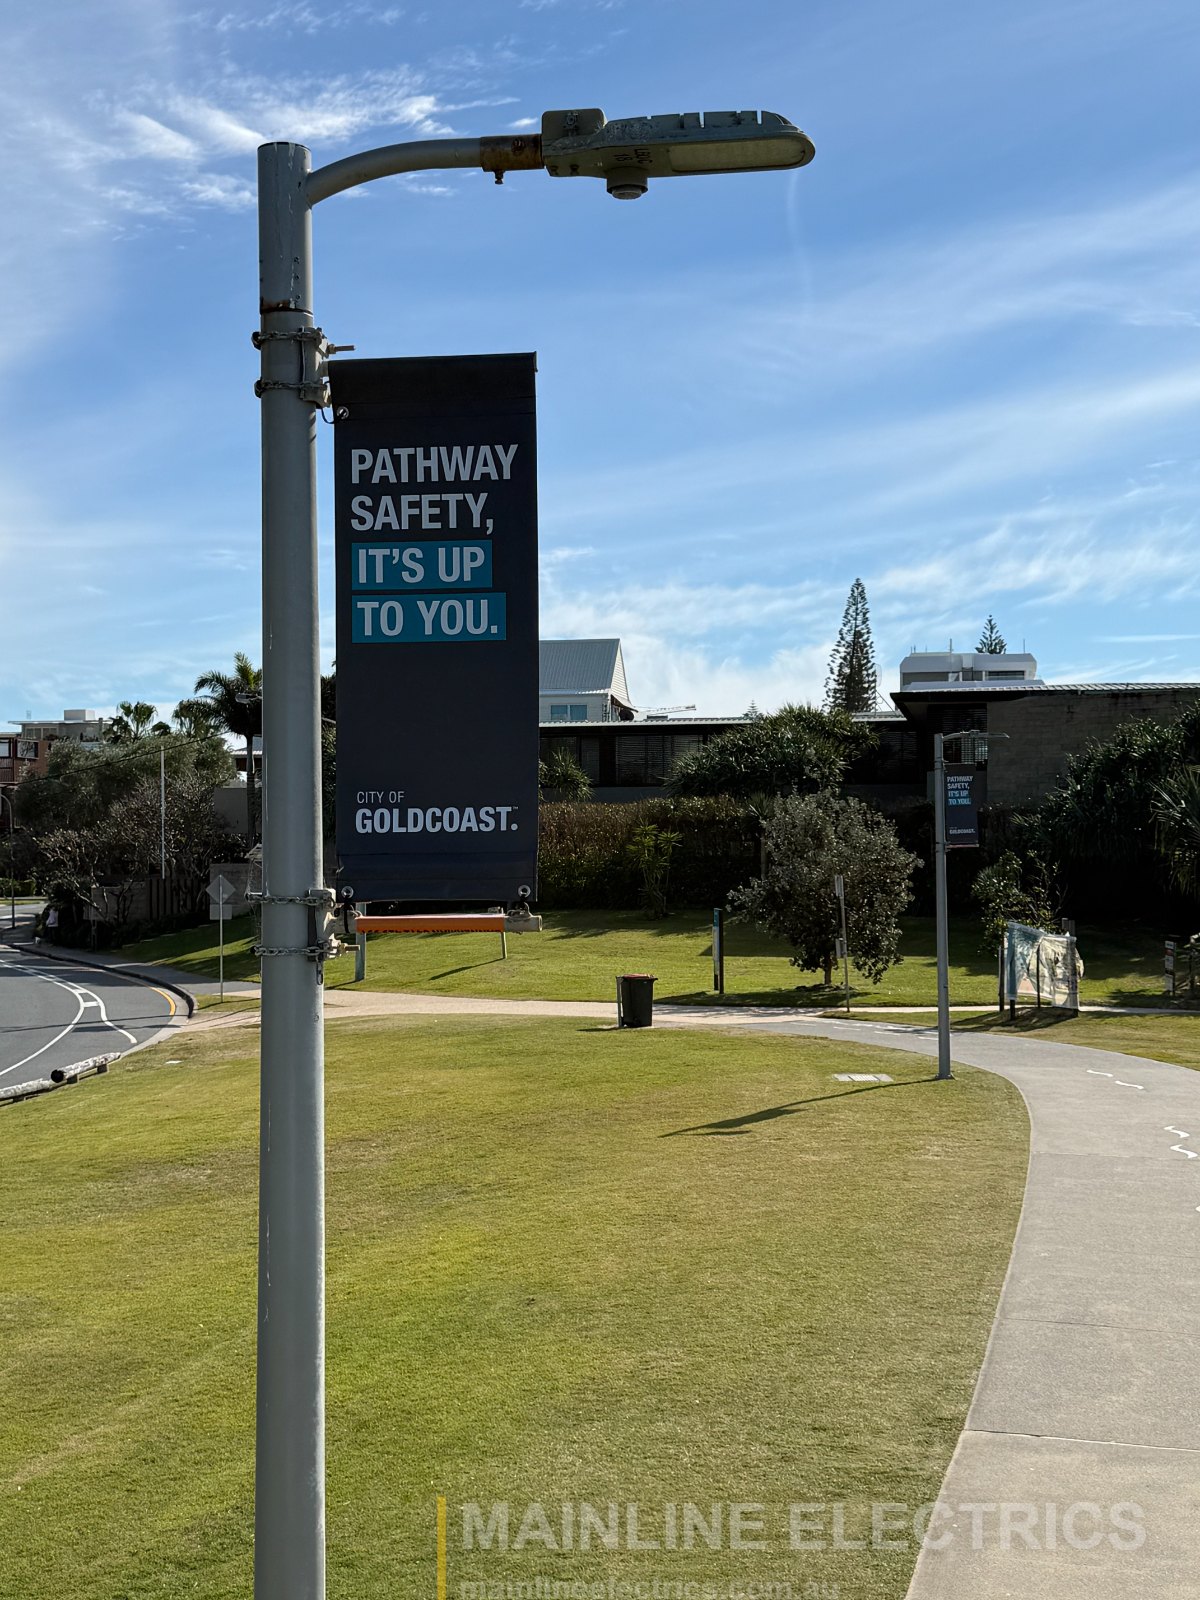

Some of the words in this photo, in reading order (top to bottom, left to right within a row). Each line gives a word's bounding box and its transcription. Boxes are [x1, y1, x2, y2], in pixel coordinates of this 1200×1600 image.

[351, 444, 519, 484] PATHWAY
[351, 492, 494, 535] SAFETY,
[358, 547, 425, 584] IT'S
[438, 546, 485, 583] UP
[357, 600, 404, 637] TO
[416, 599, 498, 636] YOU.
[356, 791, 385, 804] CITY
[388, 790, 405, 804] OF
